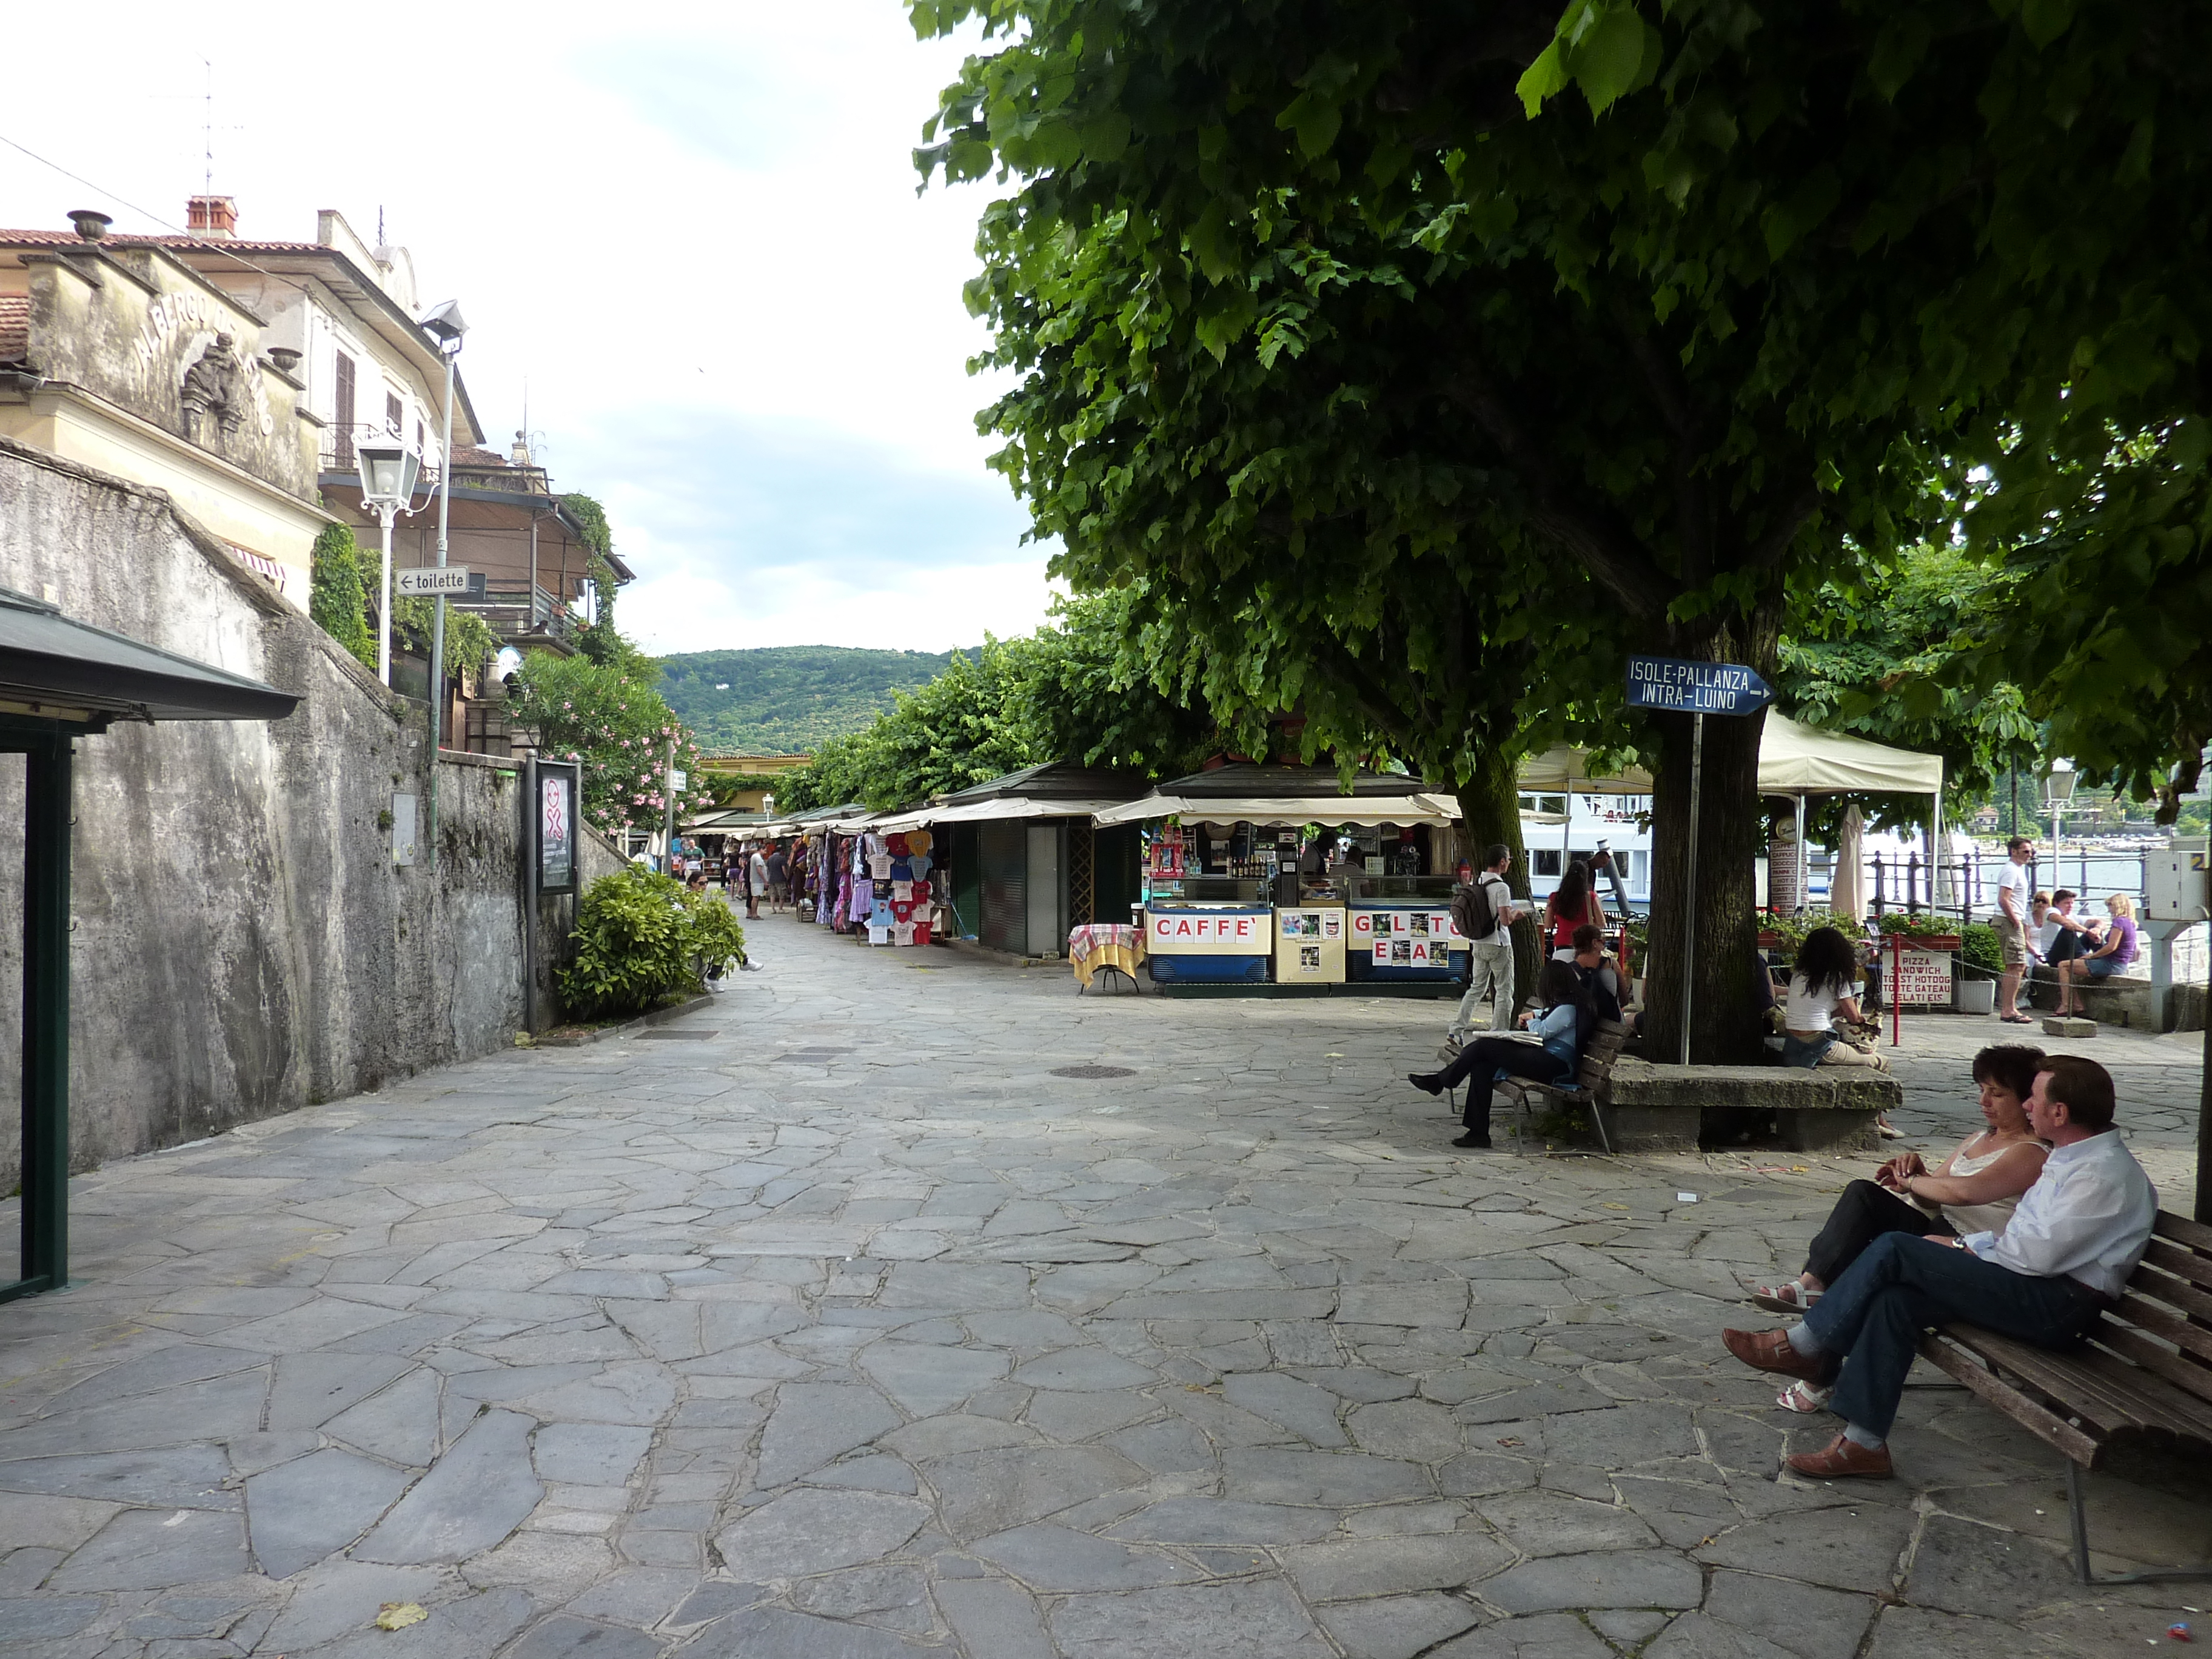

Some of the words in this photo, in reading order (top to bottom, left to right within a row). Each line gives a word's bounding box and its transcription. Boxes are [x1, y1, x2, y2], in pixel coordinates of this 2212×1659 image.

[133, 290, 206, 372] ALBERGO
[416, 572, 464, 589] toilette
[2191, 853, 2205, 871] 2
